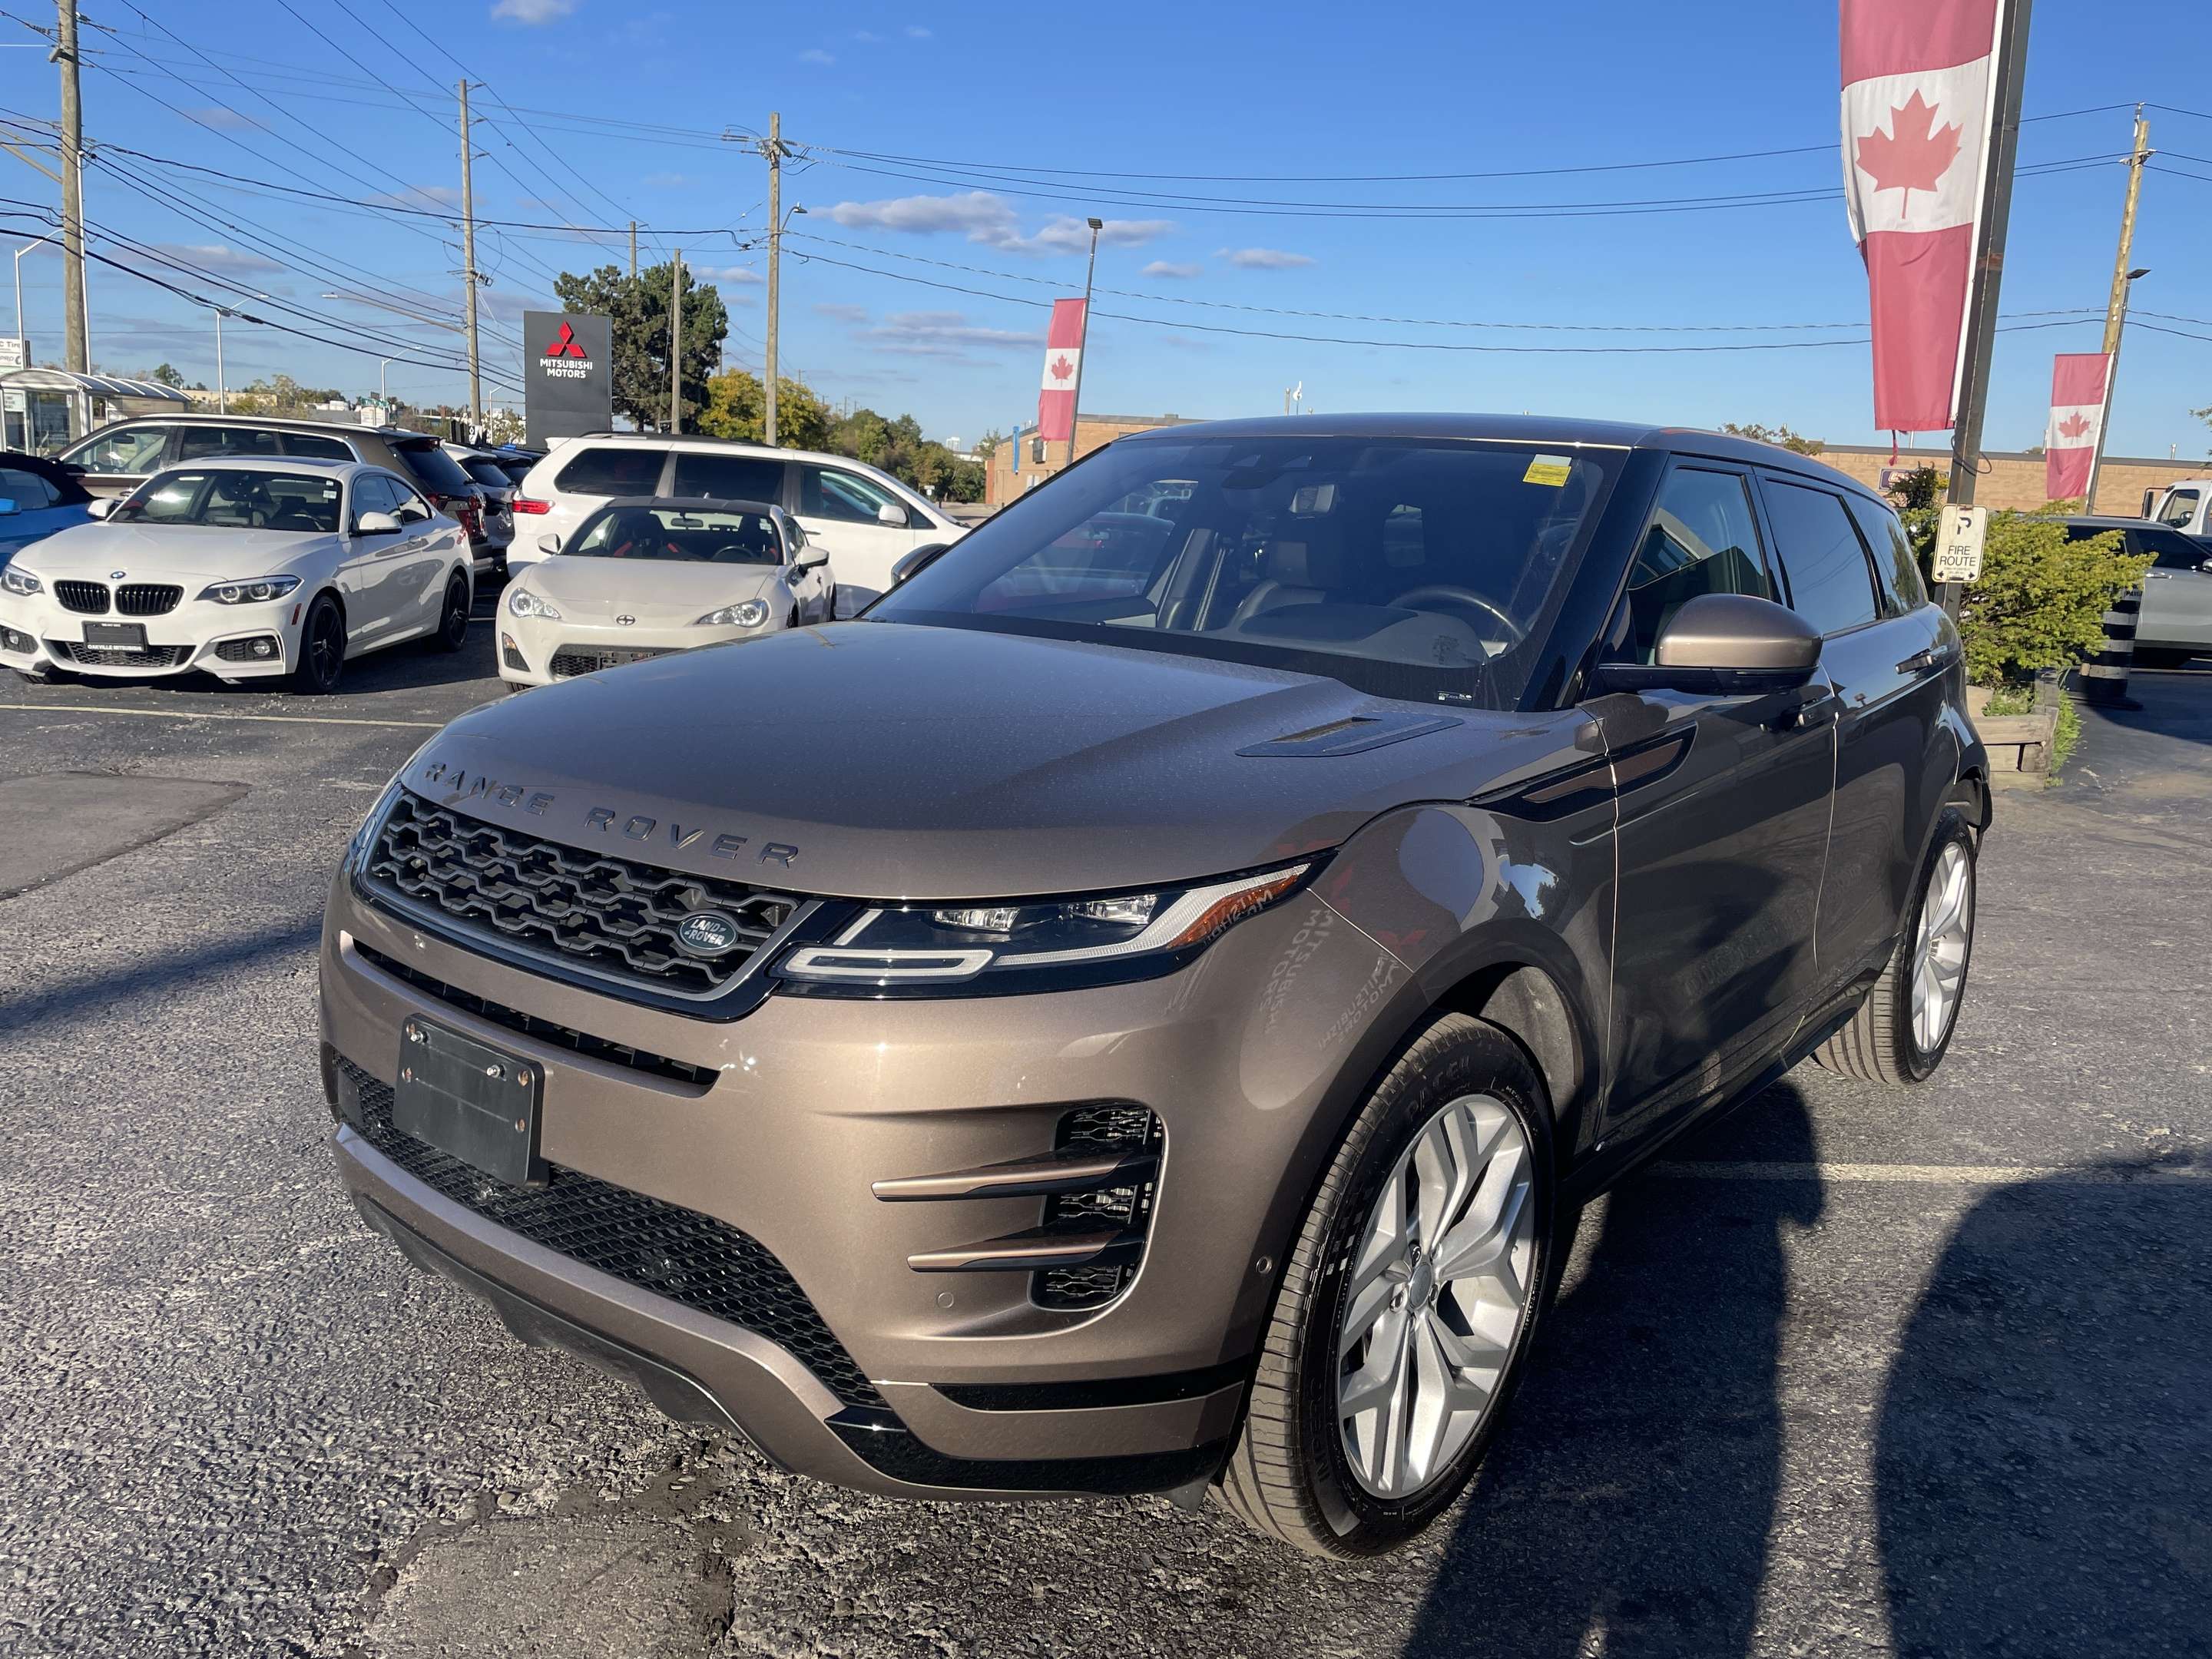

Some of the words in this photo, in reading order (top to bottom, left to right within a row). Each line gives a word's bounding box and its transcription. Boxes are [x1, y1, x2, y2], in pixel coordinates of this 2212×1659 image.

[540, 359, 593, 370] MITSUBISHI
[547, 368, 586, 379] MOTORS
[1948, 545, 1971, 555] FIRE
[1939, 555, 1976, 566] ROUTE
[426, 762, 555, 816] RANGE
[584, 806, 799, 869] ROVER
[690, 919, 720, 932] LAND
[688, 929, 724, 945] ROVER
